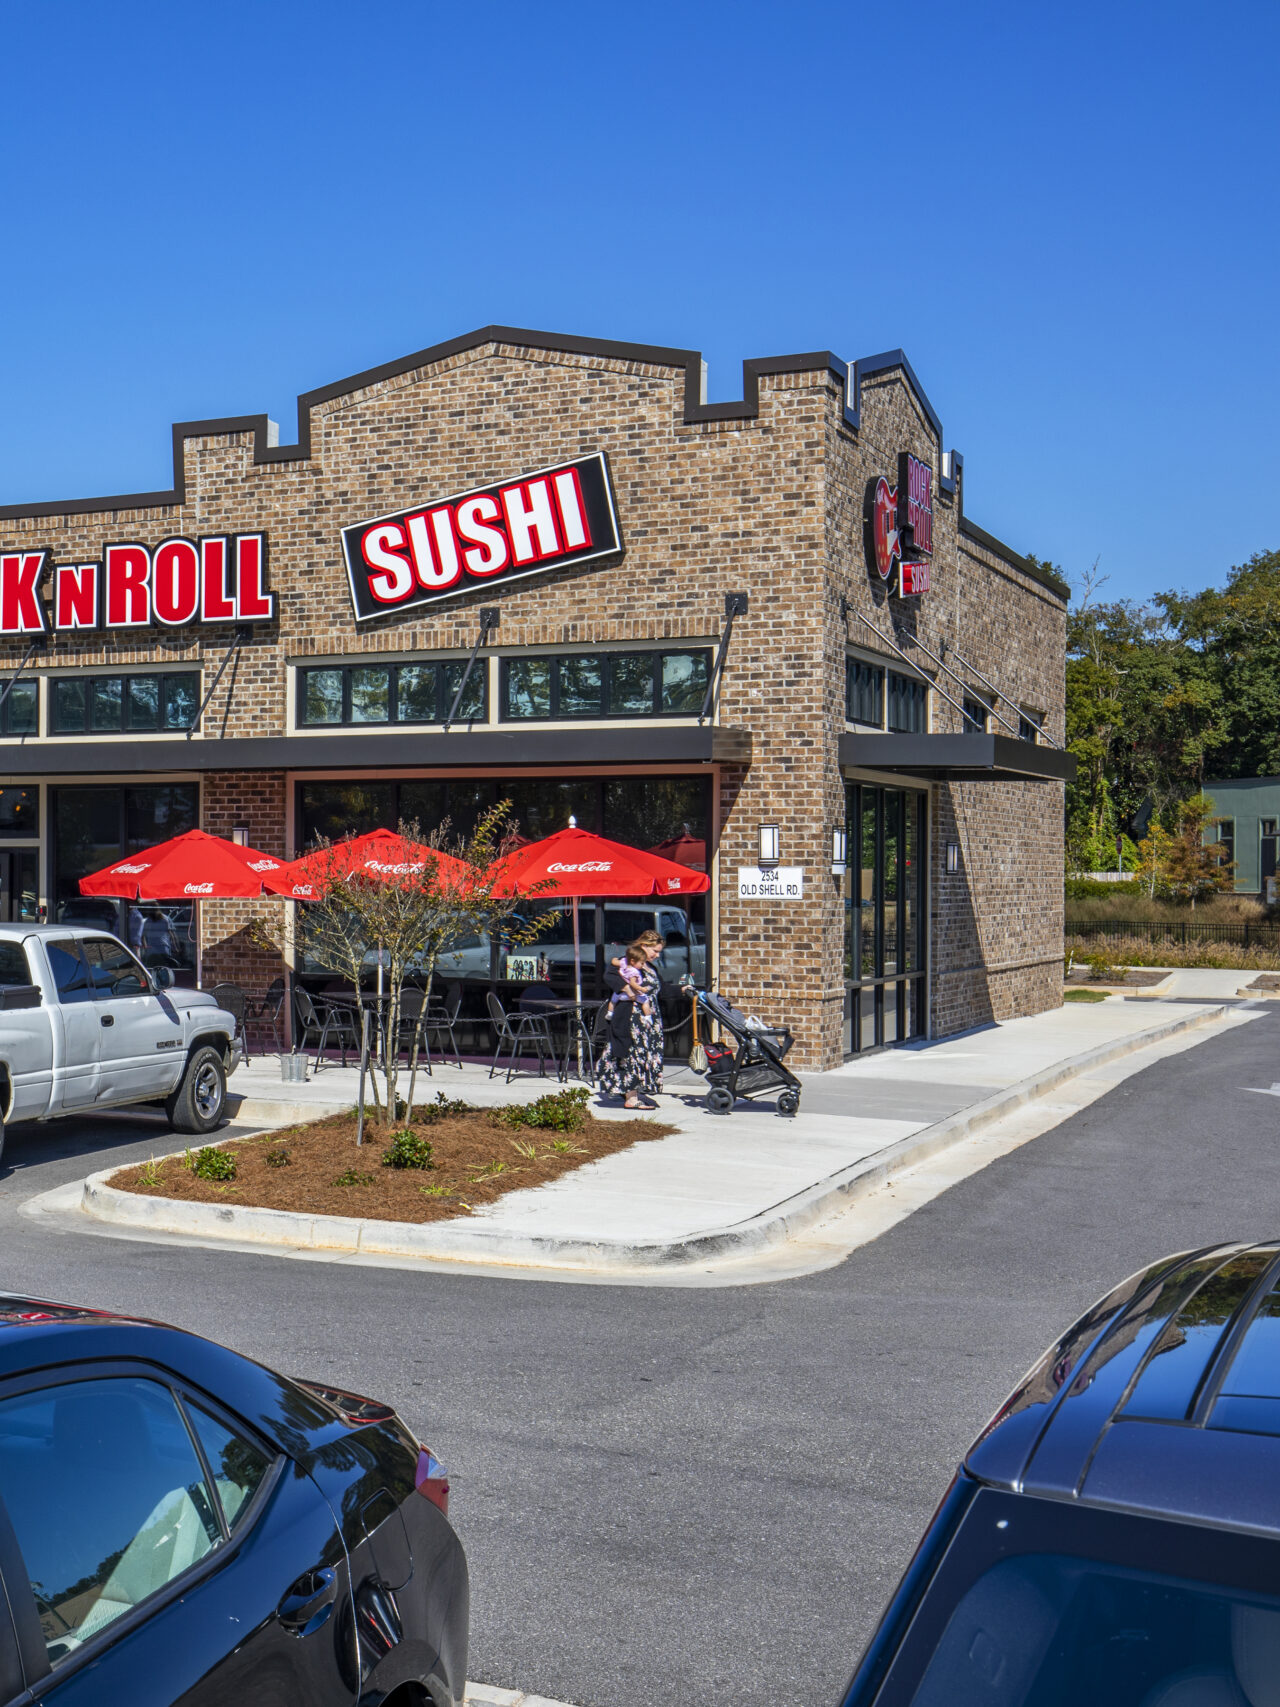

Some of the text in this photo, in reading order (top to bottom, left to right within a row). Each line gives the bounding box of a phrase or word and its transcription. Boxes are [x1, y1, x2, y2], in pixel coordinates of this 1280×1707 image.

[908, 454, 932, 513] ROCK
[360, 467, 593, 604] SUSHI
[913, 506, 933, 555] ROLL
[106, 534, 273, 627] ROLL
[911, 562, 930, 594] SUSHI
[547, 861, 613, 873] Coca-Cola
[761, 870, 779, 881] 2534
[184, 883, 214, 893] Coca-Cola
[741, 884, 800, 895] OLD SHELL RD.
